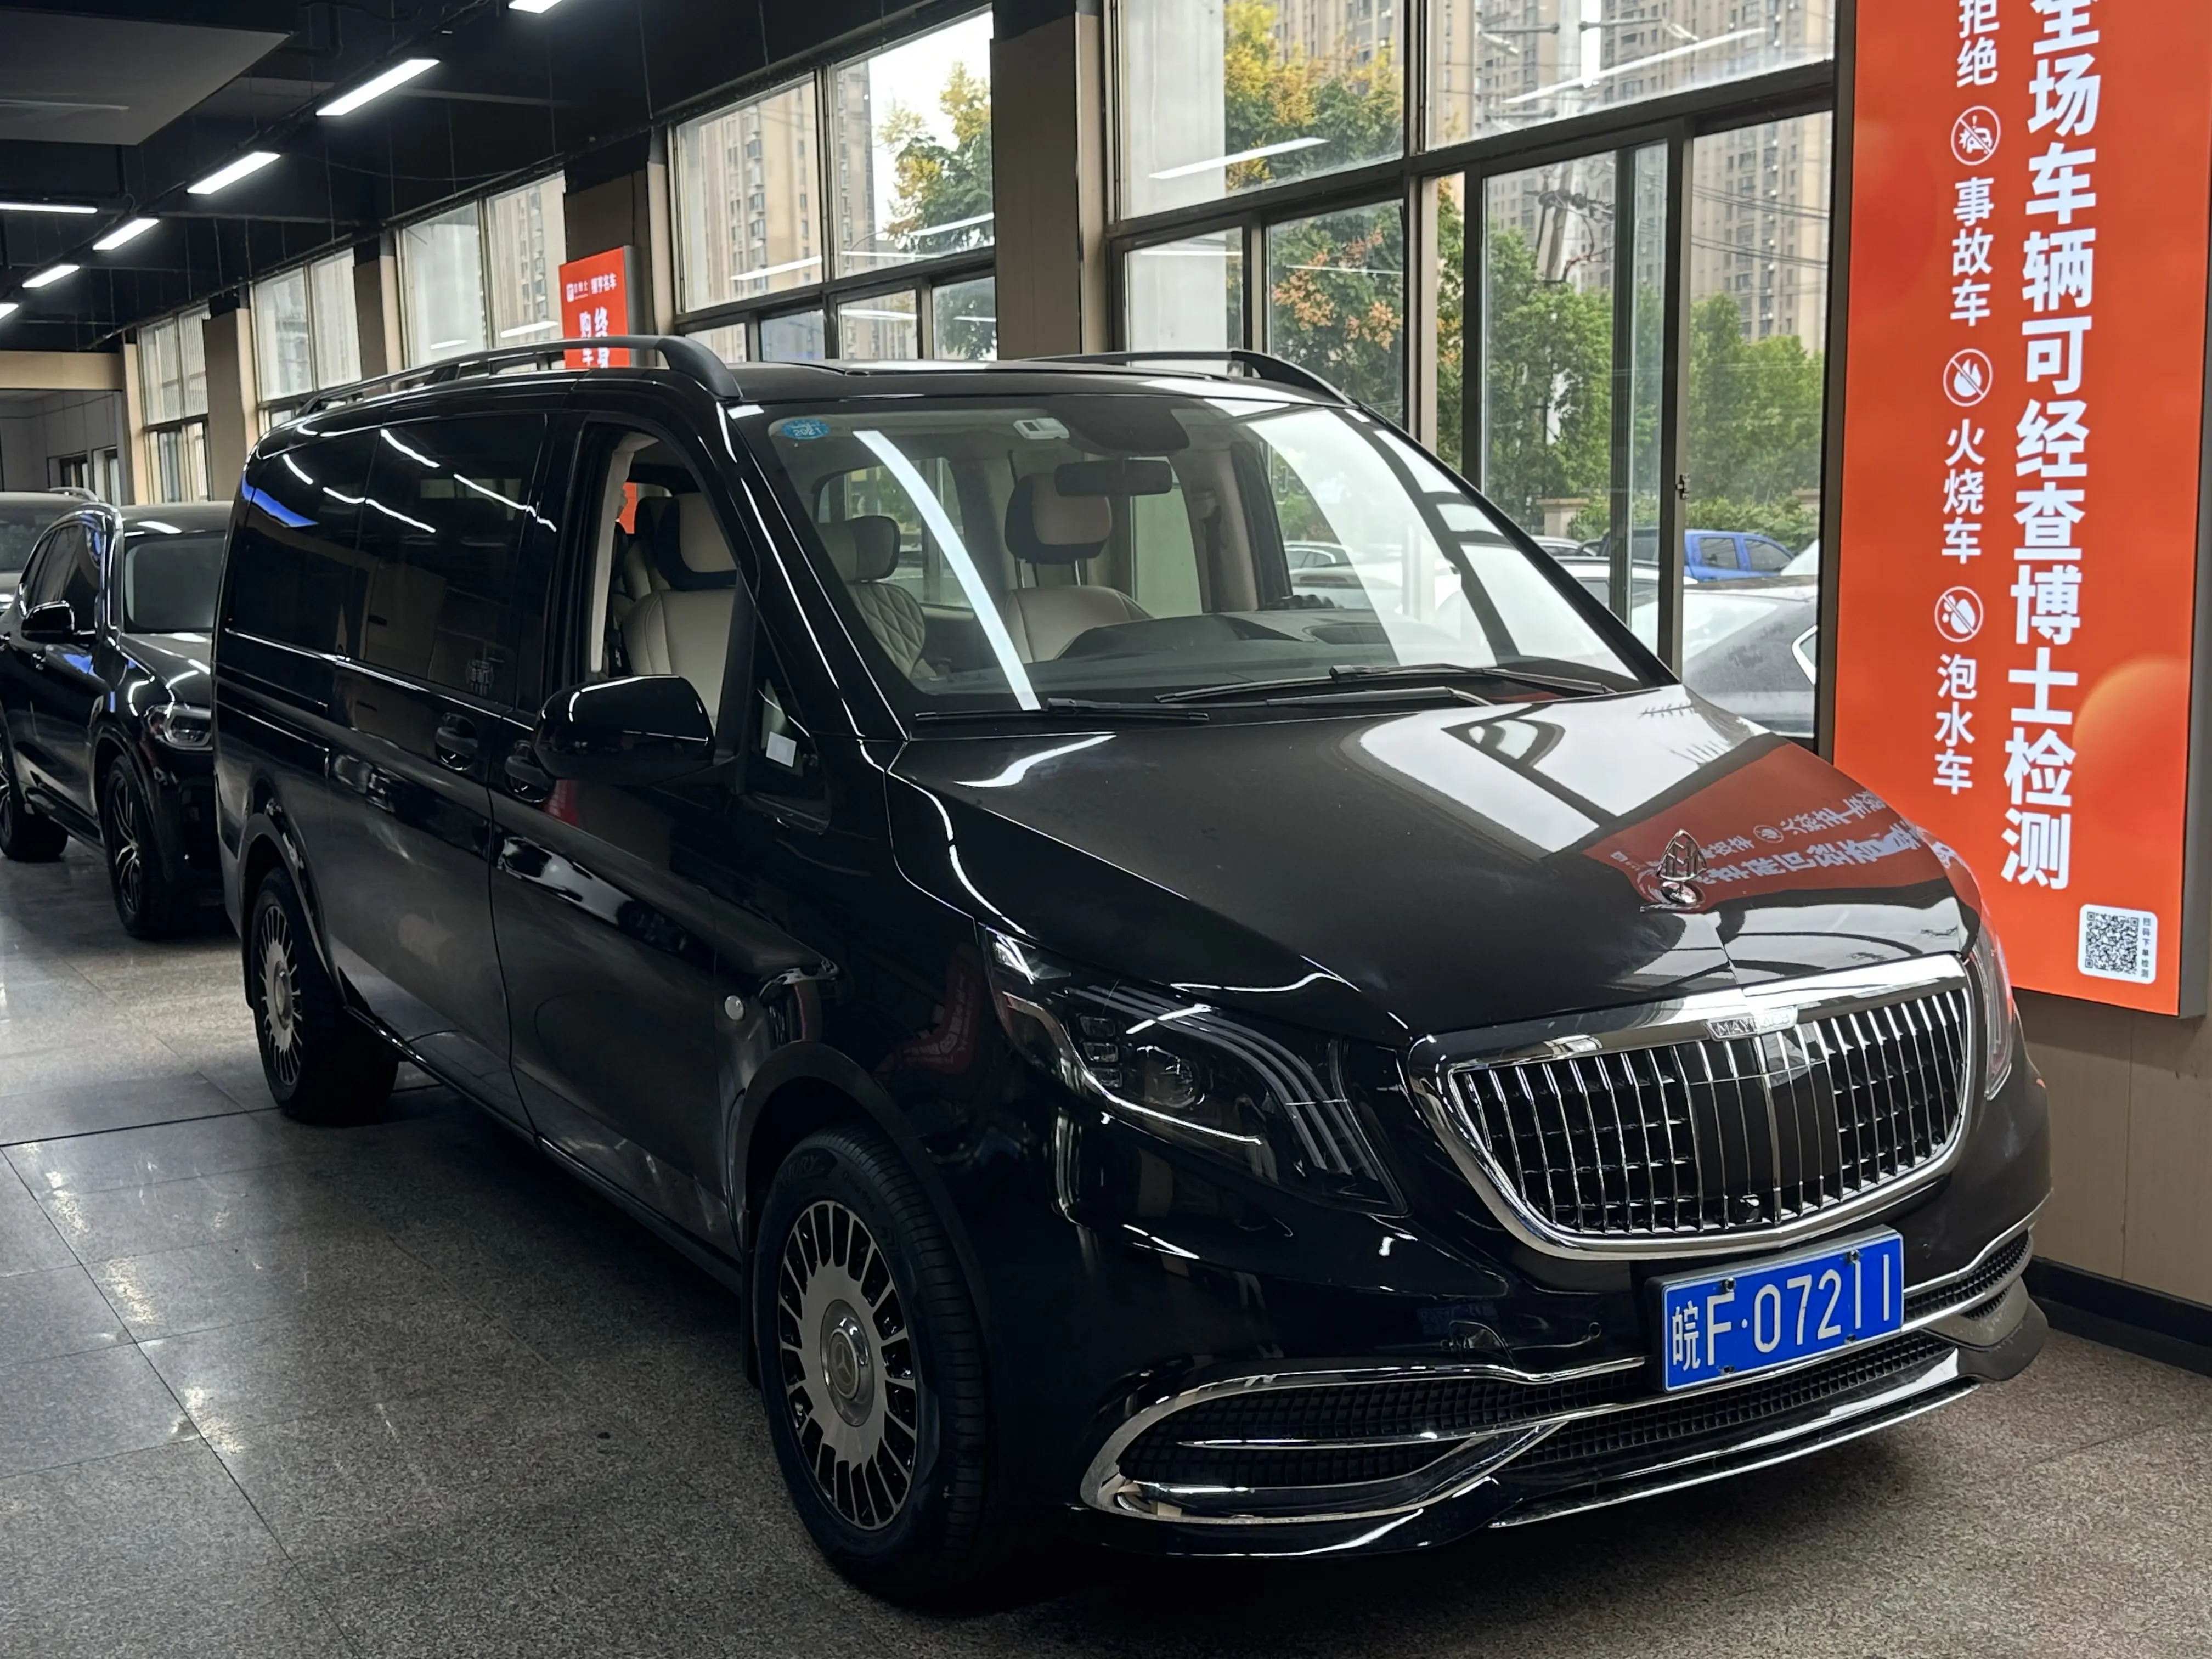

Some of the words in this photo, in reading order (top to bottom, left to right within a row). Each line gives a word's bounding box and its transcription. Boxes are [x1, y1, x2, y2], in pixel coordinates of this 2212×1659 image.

[1957, 0, 2000, 87] 拒绝
[1951, 177, 1994, 326] 事故车
[1942, 419, 1985, 564] 火烧车
[2001, 0, 2101, 889] 全场车辆可经查博士检测
[1933, 653, 1977, 795] 泡水车
[1671, 1254, 1890, 1372] 皖F·07211
